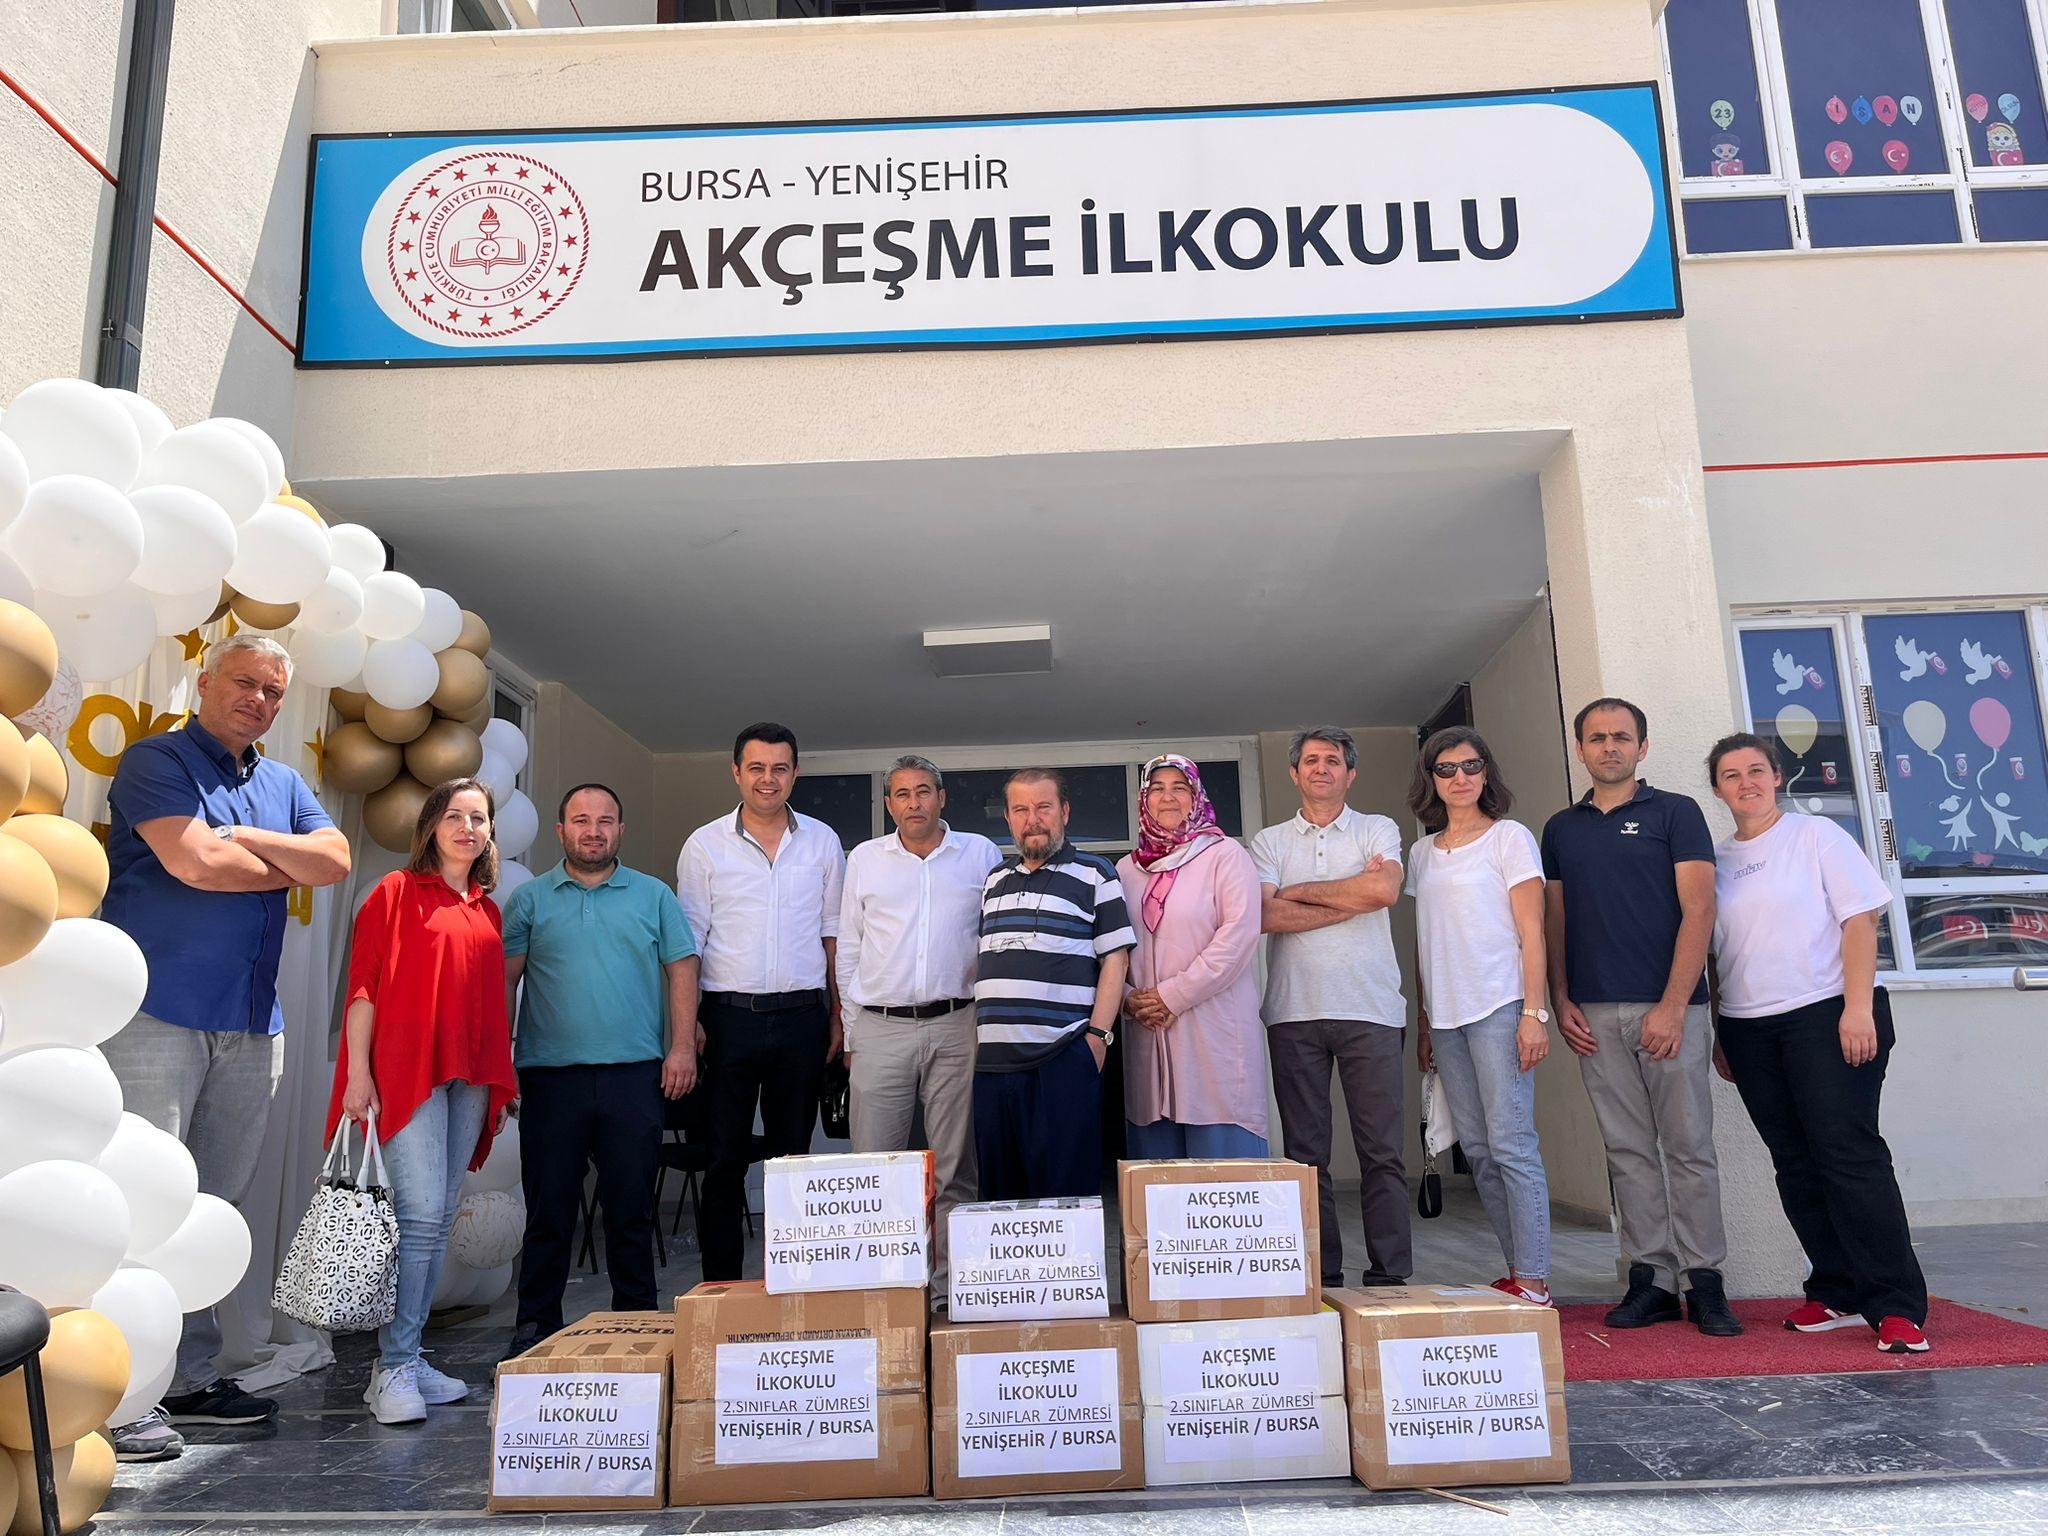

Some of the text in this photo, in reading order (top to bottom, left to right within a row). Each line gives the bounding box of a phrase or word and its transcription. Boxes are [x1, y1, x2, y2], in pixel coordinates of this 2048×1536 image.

[1714, 109, 1731, 118] 23
[642, 169, 770, 203] BURSA
[806, 154, 1009, 201] YENİŞEHİR
[425, 185, 482, 258] CUMHURİYETİ
[524, 197, 553, 237] EĞİTİM
[639, 197, 1519, 306] AKÇEŞME İLKOKULU
[501, 242, 553, 300] BAKANLIĞI
[429, 262, 472, 301] TÜRKİYE
[806, 1176, 879, 1194] AKÇEŞME
[806, 1199, 881, 1216] İLKOKULU
[1188, 1191, 1259, 1208] AKÇEŞME
[773, 1217, 917, 1243] 2.SINIFLAR ZÜMRESİ
[991, 1220, 1063, 1238] AKÇEŞME
[1187, 1213, 1262, 1229] İLKOKULU
[770, 1242, 921, 1265] YENİŞEHİR / BURSA
[991, 1243, 1065, 1259] İLKOKULU
[1156, 1234, 1297, 1254] 2.SINIFLAR ZÜMRESİ
[959, 1262, 1101, 1284] 2.SINIFLAR ZÜMRESİ
[1152, 1257, 1301, 1277] YENİŞEHİR / BURSA
[955, 1287, 1105, 1307] YENİŞEHİR / BURSA
[759, 1350, 834, 1368] AKÇEŞME
[1202, 1348, 1276, 1366] AKÇEŞME
[1423, 1344, 1498, 1364] AKÇEŞME
[1000, 1360, 1075, 1378] AKÇEŞME
[1423, 1369, 1502, 1386] İLKOKULU
[757, 1374, 835, 1390] İLKOKULU
[1202, 1372, 1279, 1388] İLKOKULU
[542, 1383, 618, 1399] AKÇEŞME
[999, 1384, 1077, 1400] İLKOKULU
[724, 1394, 870, 1415] 2.SINIFLAR ZÜMRESİ
[1171, 1392, 1314, 1414] 2.SINIFLAR ZÜMRESİ
[1392, 1390, 1539, 1414] 2.SINIFLAR ZÜMRESİ
[539, 1405, 617, 1422] İLKOKULU
[966, 1404, 1112, 1426] 2.SINIFLAR ZÜMRESİ
[719, 1420, 874, 1439] YENİŞEHİR / BURSA
[1167, 1417, 1319, 1438] YENİŞEHİR / BURSA
[1389, 1416, 1544, 1439] YENİŞEHİR / BURSA
[502, 1430, 649, 1448] 2.SINIFLAR ZÜMRESİ
[962, 1430, 1116, 1451] YENİŞEHİR / BURSA
[498, 1453, 652, 1473] YENİŞEHİR / BURSA
